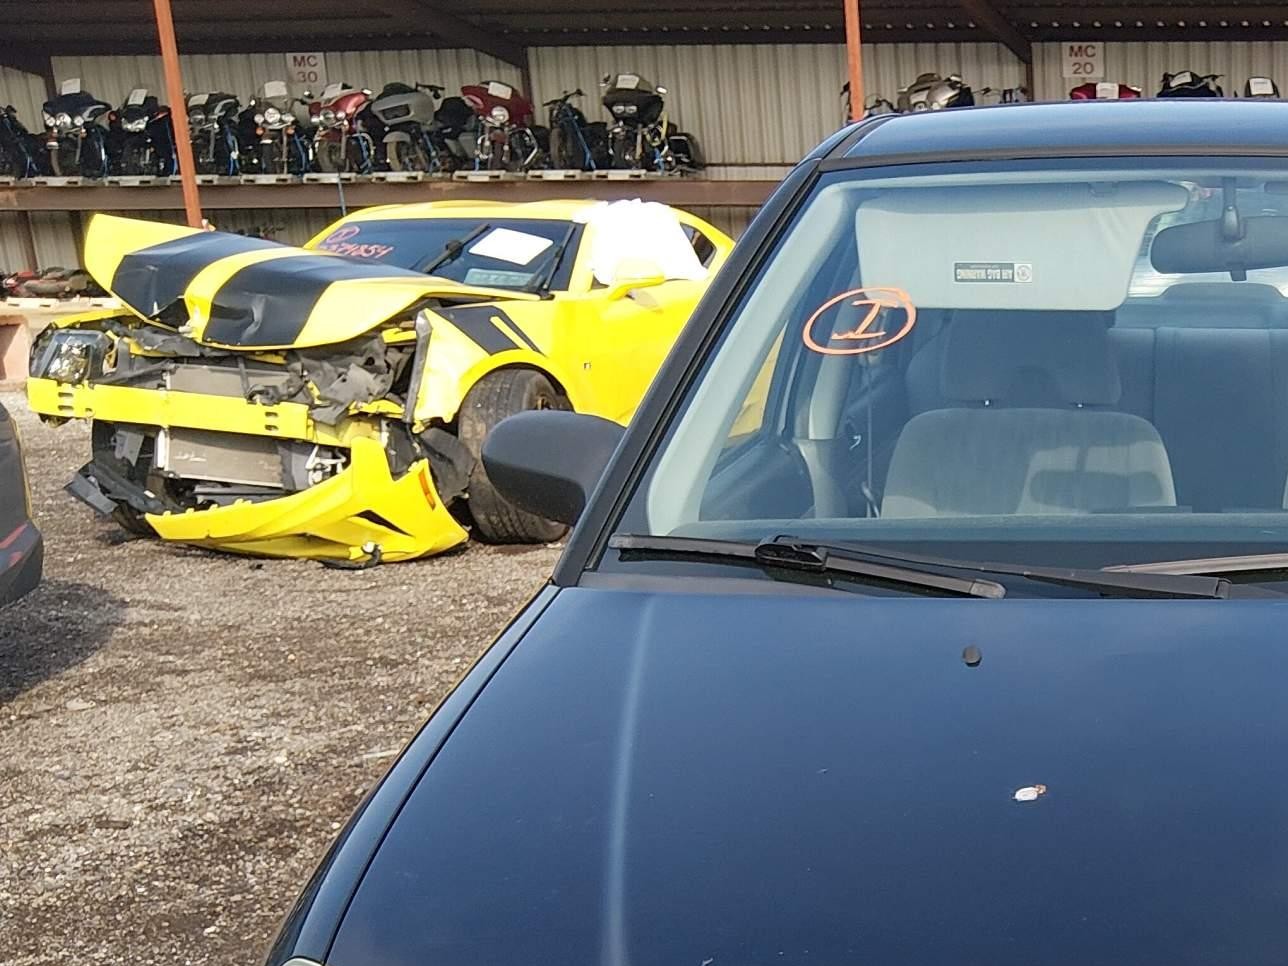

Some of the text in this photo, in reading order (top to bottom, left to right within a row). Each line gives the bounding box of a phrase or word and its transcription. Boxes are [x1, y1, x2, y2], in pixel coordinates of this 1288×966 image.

[1069, 45, 1096, 58] MC
[293, 55, 318, 67] MC
[1072, 62, 1095, 75] 20
[297, 71, 318, 83] 30
